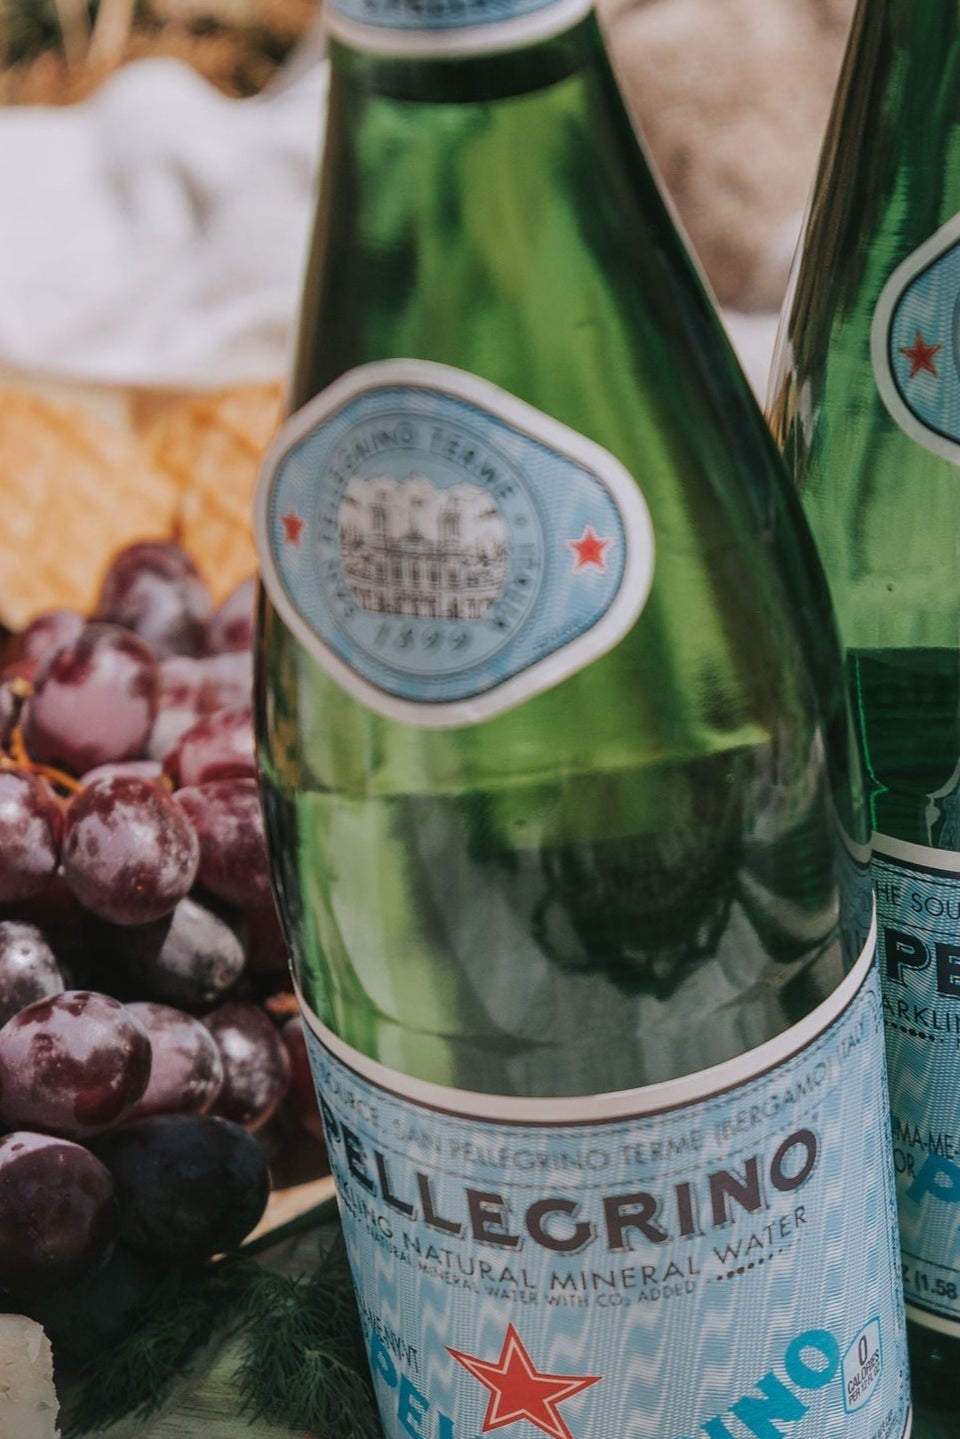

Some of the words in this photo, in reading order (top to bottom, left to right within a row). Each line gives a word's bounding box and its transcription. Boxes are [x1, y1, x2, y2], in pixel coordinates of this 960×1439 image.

[875, 879, 903, 907] HE
[402, 1231, 536, 1291] NATURAL
[550, 1255, 702, 1292] MINERAL
[712, 1204, 808, 1265] WATER
[638, 1279, 698, 1303] ADDED
[914, 1270, 958, 1301] (1.58
[858, 1334, 869, 1367] 0
[846, 1348, 880, 1396] CALORIES
[848, 1388, 861, 1406] PER
